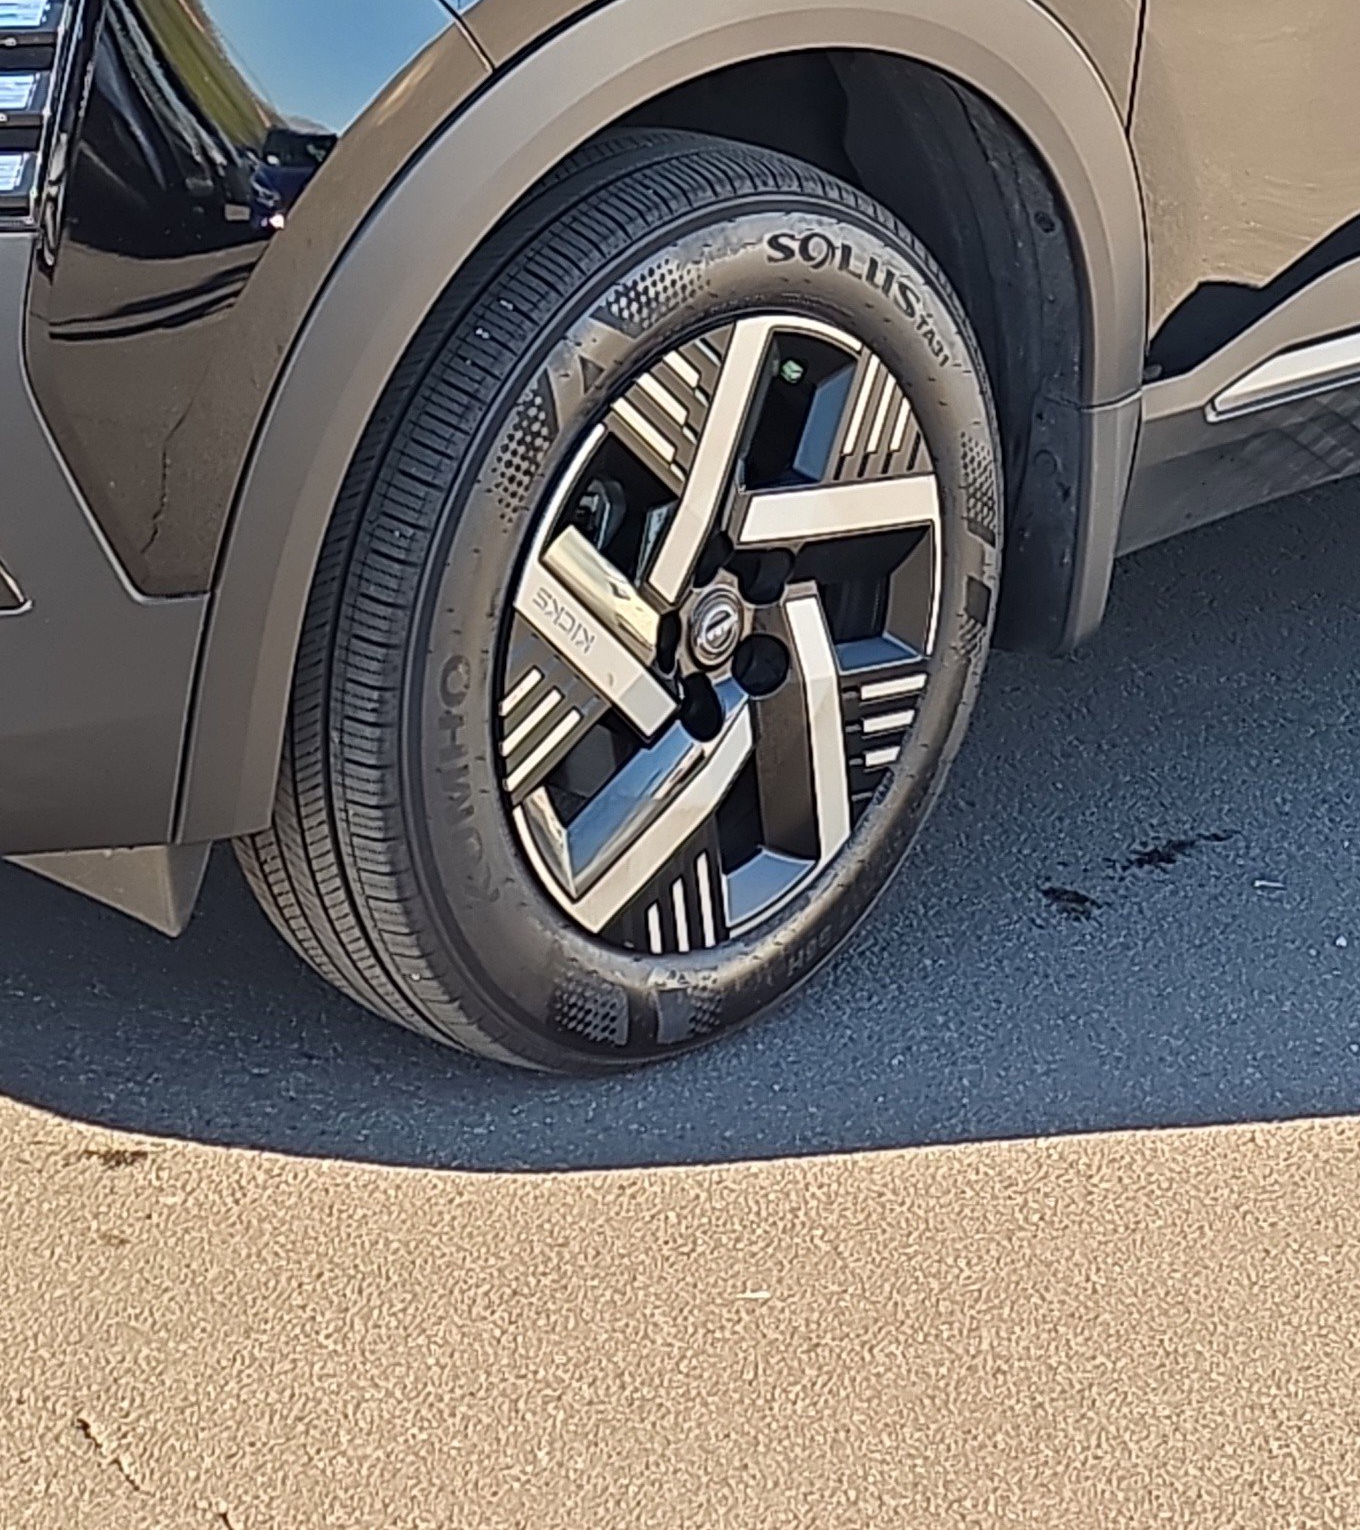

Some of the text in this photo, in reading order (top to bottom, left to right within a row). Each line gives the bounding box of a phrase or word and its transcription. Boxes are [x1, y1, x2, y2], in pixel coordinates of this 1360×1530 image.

[766, 230, 951, 368] SOLUS TA31
[532, 586, 596, 655] KICKS
